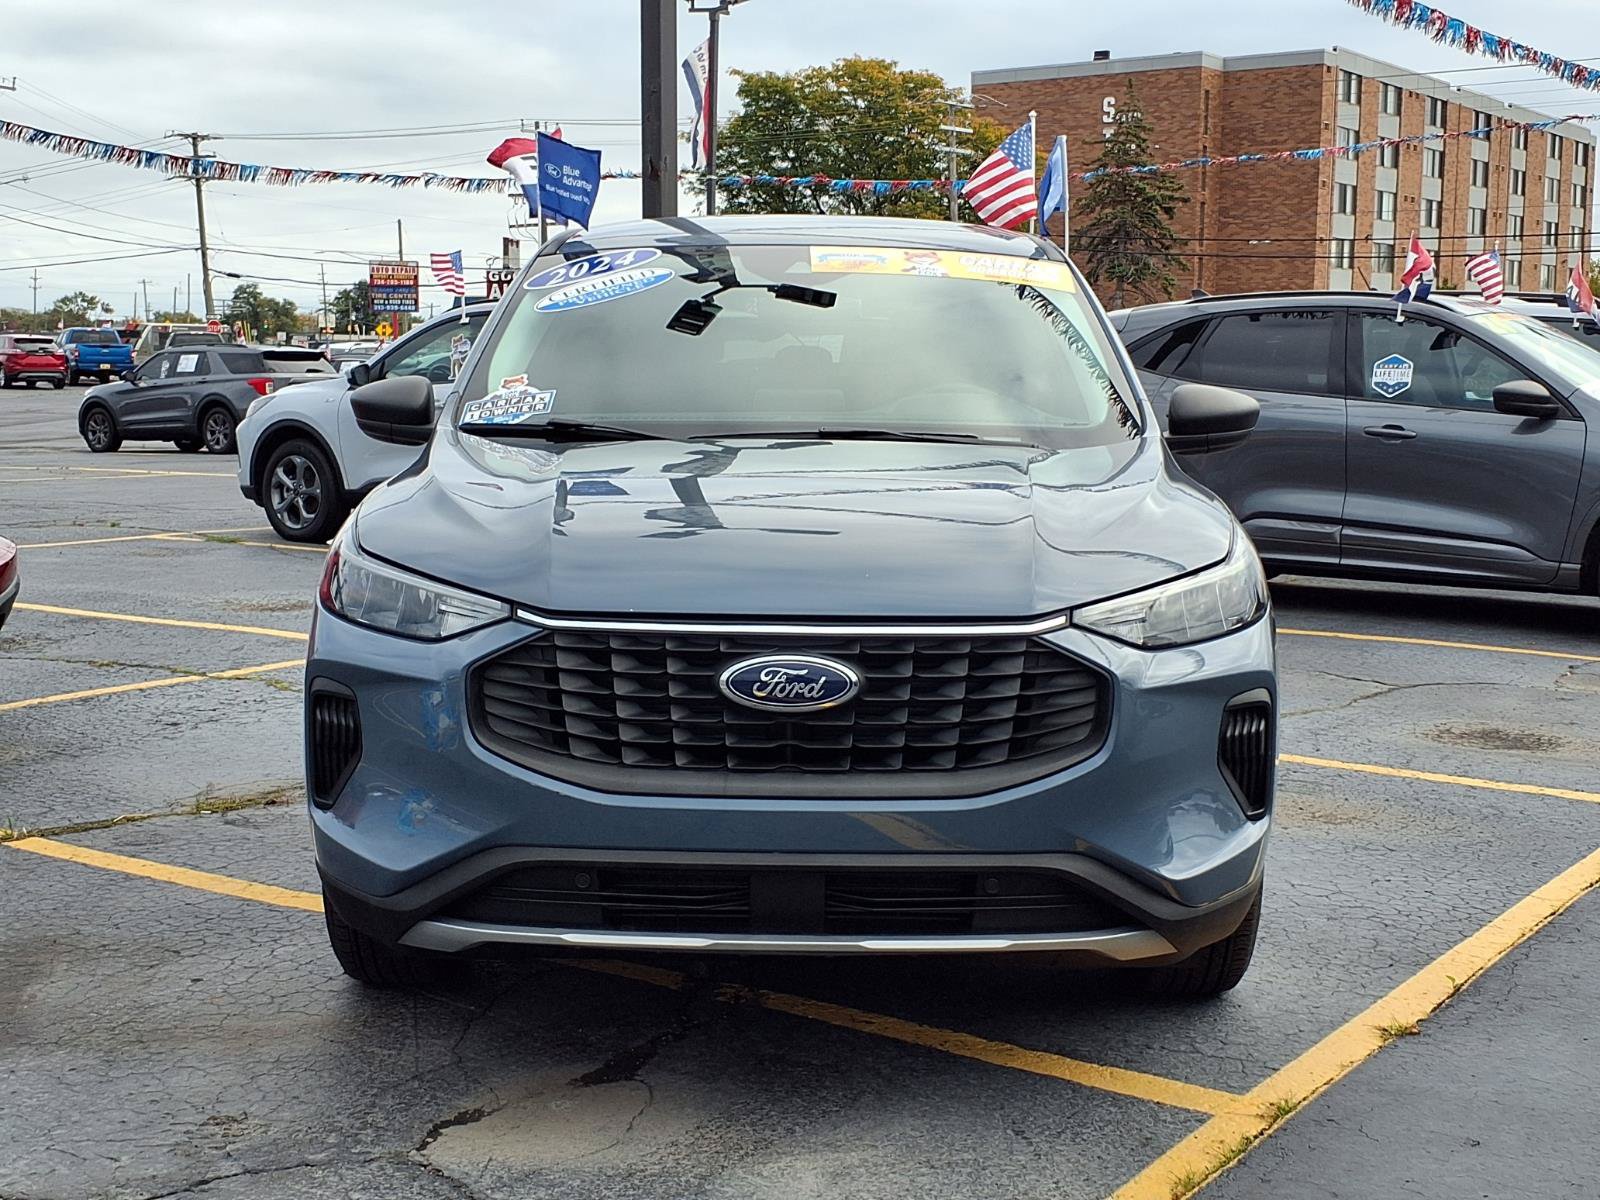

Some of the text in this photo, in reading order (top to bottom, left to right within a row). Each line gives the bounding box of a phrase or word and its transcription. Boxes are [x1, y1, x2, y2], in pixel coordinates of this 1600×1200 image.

[563, 165, 580, 177] Blue
[391, 266, 416, 274] REPAIR
[545, 250, 637, 287] 2024
[549, 268, 656, 302] CERTIFIED
[1374, 369, 1411, 378] LIFETIME
[470, 393, 547, 412] CARFAX
[480, 402, 546, 418] OWNER
[752, 667, 827, 698] Ford
